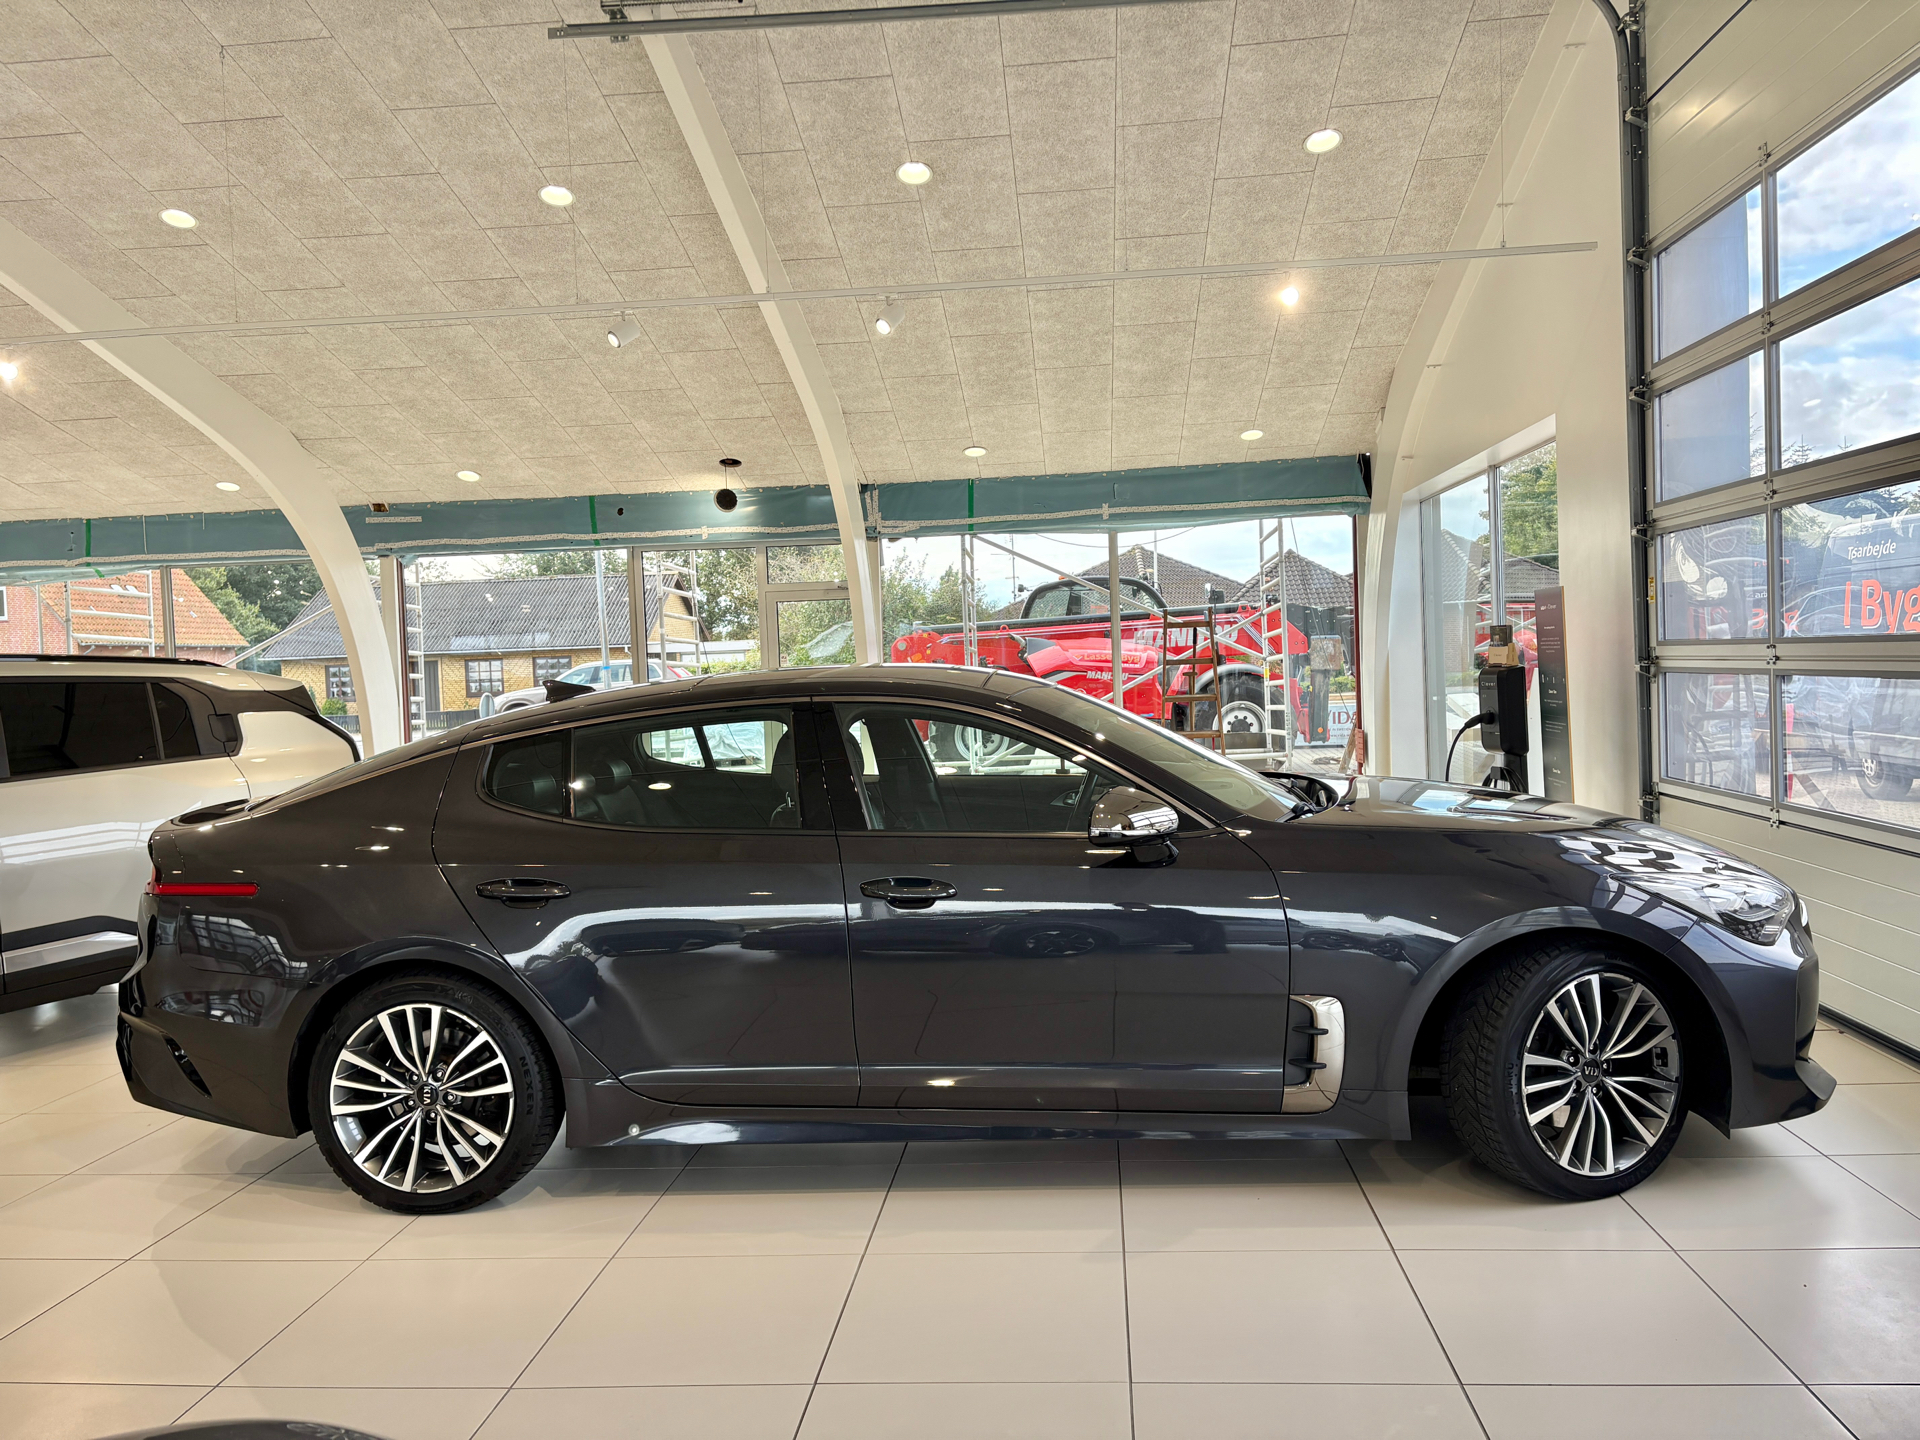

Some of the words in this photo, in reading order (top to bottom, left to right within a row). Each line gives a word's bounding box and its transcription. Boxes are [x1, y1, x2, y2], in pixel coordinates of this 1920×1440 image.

[1086, 670, 1129, 681] MANIU
[1584, 1065, 1600, 1077] KIA
[519, 1055, 535, 1116] NEXEN
[423, 1086, 431, 1104] KIA
